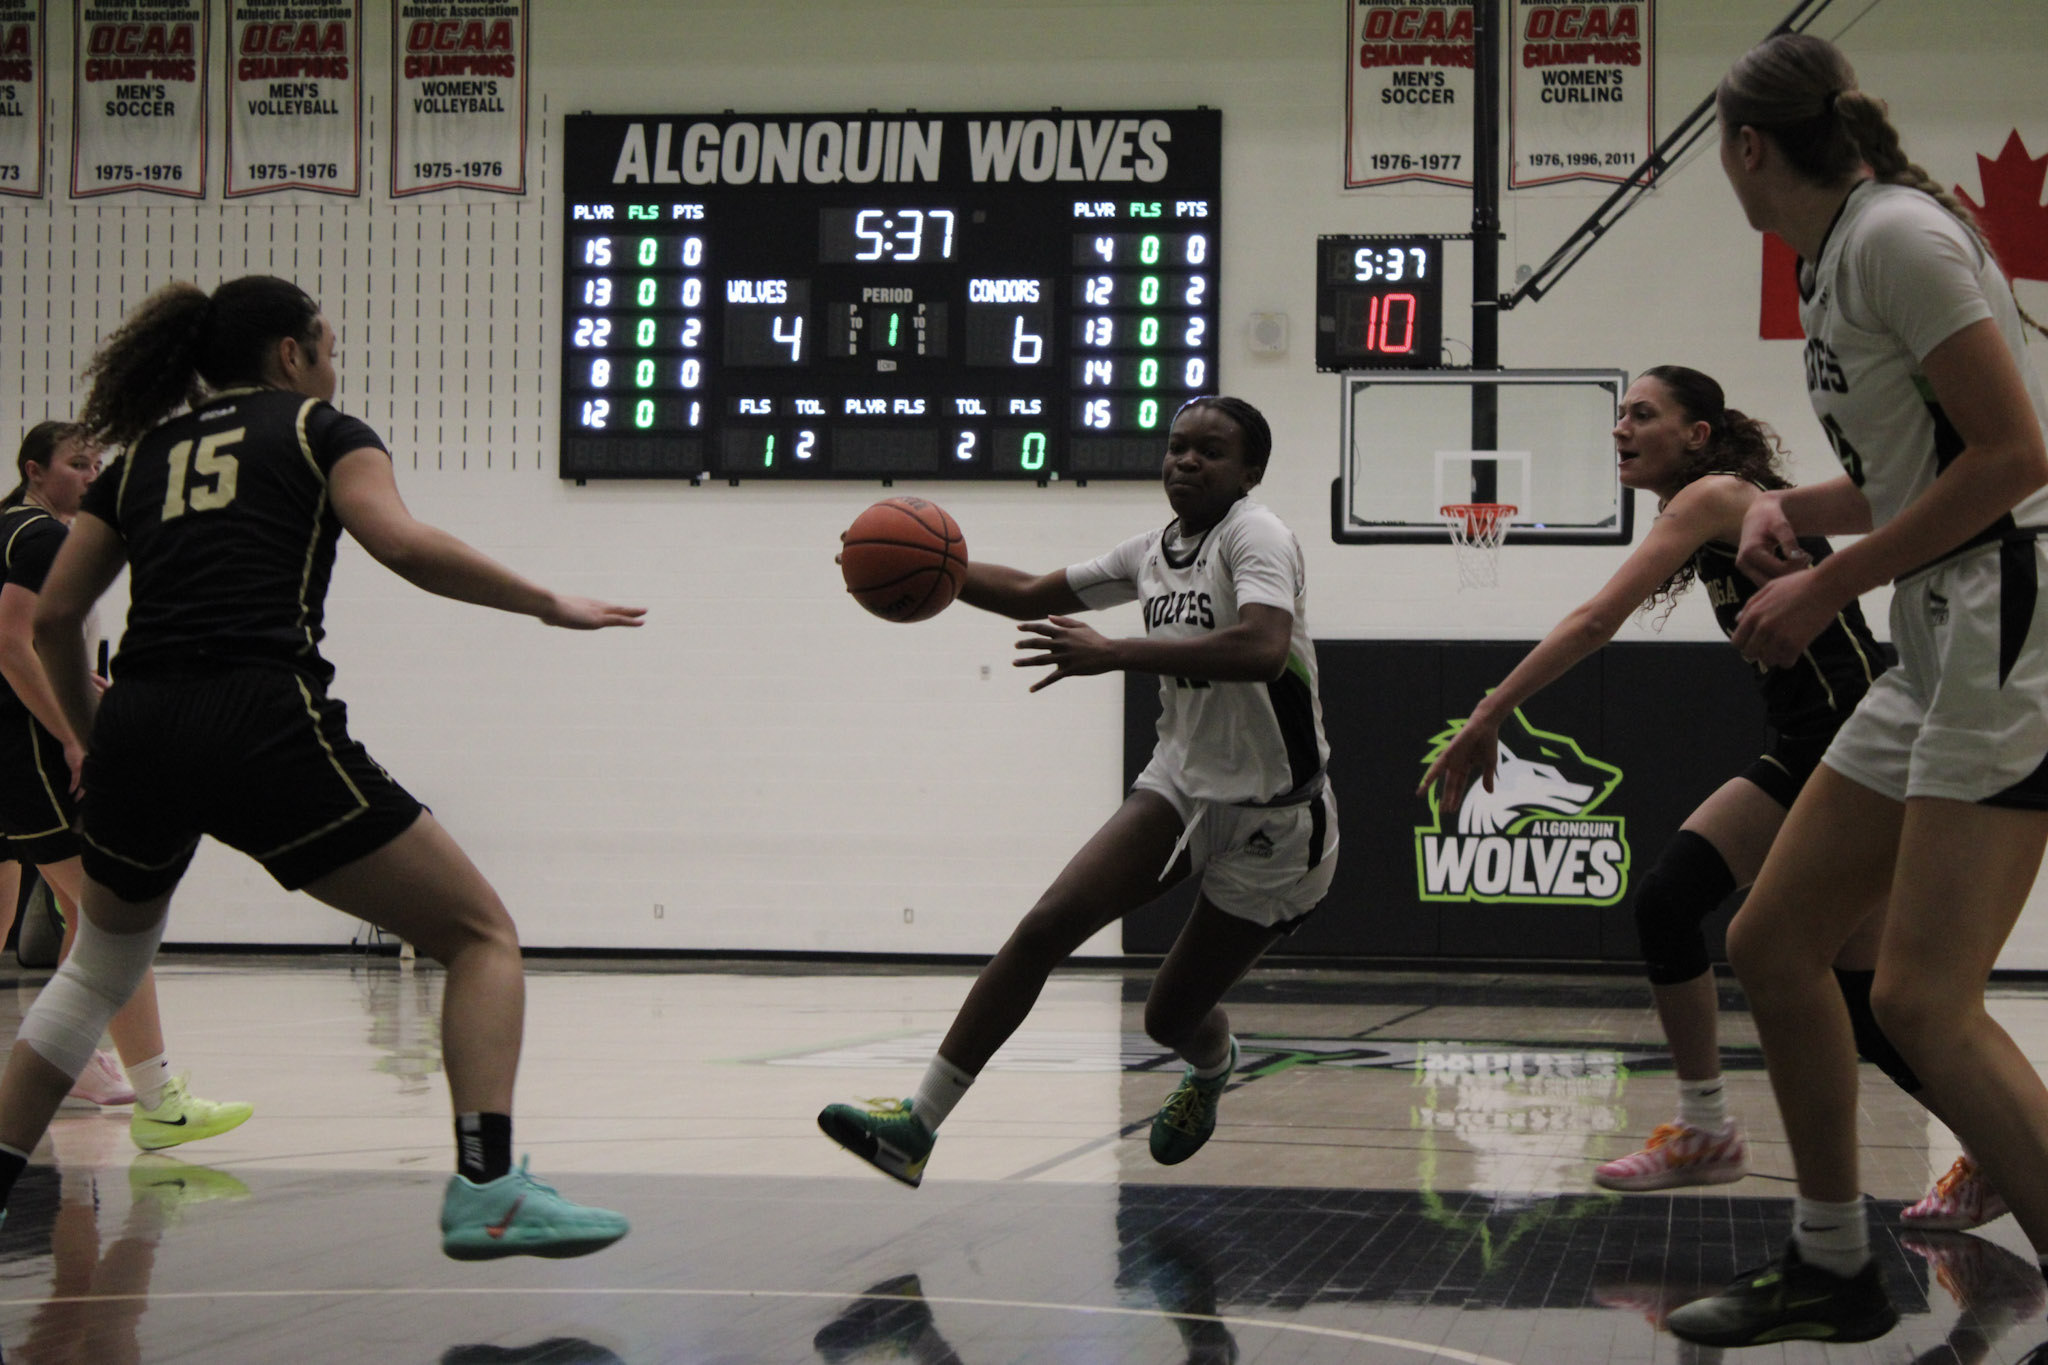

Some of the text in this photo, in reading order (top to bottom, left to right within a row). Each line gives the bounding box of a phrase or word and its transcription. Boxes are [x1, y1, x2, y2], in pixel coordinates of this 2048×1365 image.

[85, 9, 200, 21] Athletic Association
[236, 7, 352, 20] Athletic Association
[403, 5, 519, 17] Athletic Association
[1524, 5, 1639, 41] OCAA
[406, 19, 513, 53] OCAA
[1362, 8, 1474, 42] OCAA
[88, 23, 194, 57] OCAA
[241, 21, 346, 55] OCAA
[404, 54, 515, 78] CHAMPIONS
[1523, 42, 1642, 68] CHAMPIONS
[86, 58, 196, 82] CHAMPIONS
[238, 56, 348, 81] CHAMPIONS
[1392, 71, 1444, 86] MEN'S
[1542, 70, 1622, 85] WOMEN'S
[116, 85, 165, 100] MEN'S
[270, 84, 318, 98] MEN'S
[422, 81, 497, 96] WOMEN'S
[1381, 88, 1454, 104] SOCCER
[1541, 87, 1623, 102] CURLING
[106, 102, 174, 116] SOCCER
[248, 100, 338, 115] VOLLEYBALL
[414, 98, 504, 113] VOLLEYBALL
[612, 120, 1171, 184] ALGONQUIN WOLVES
[1370, 154, 1461, 170] 1976-1977
[1529, 153, 1635, 168] 1976, 1996, 2011
[96, 165, 182, 180] 1975-1976
[248, 164, 337, 179] 1975-1976
[414, 162, 502, 178] 1975-1976
[573, 204, 704, 220] PLYR FLS PTS
[1074, 202, 1208, 217] PLYR FLS PTS
[855, 210, 954, 260] 5:37
[584, 237, 702, 266] 15 0 0
[1096, 235, 1206, 264] 4 0 0
[1354, 248, 1426, 281] 5:37
[584, 278, 702, 307] 13 0 0
[727, 280, 787, 304] WOLVES
[863, 288, 913, 303] PERIOD
[969, 279, 1040, 303] CONDORS
[1086, 276, 1205, 305] 12 0 2
[574, 318, 701, 346] 22 0 2
[850, 317, 863, 329] TO
[888, 312, 899, 347] 1
[912, 316, 926, 329] TO
[1085, 317, 1205, 346] 13 0 2
[1367, 293, 1416, 353] 10
[772, 316, 803, 362] 4
[1013, 316, 1042, 364] 6
[591, 358, 700, 388] 8 0 0
[1084, 358, 1205, 387] 14 0 0
[582, 399, 700, 428] 12 0 1
[740, 399, 772, 414] FLS
[795, 399, 826, 414] TOL
[846, 399, 925, 414] PLYR FLS
[956, 399, 986, 414] TOL
[1010, 399, 1042, 414] FLS
[1084, 399, 1158, 428] 15 0
[764, 434, 775, 467] 1
[796, 431, 815, 458] 2
[957, 432, 976, 460] 2
[1021, 432, 1046, 470] 0
[162, 426, 246, 522] 15
[1532, 821, 1614, 838] ALGONQUIN
[1424, 836, 1622, 898] WOLVES
